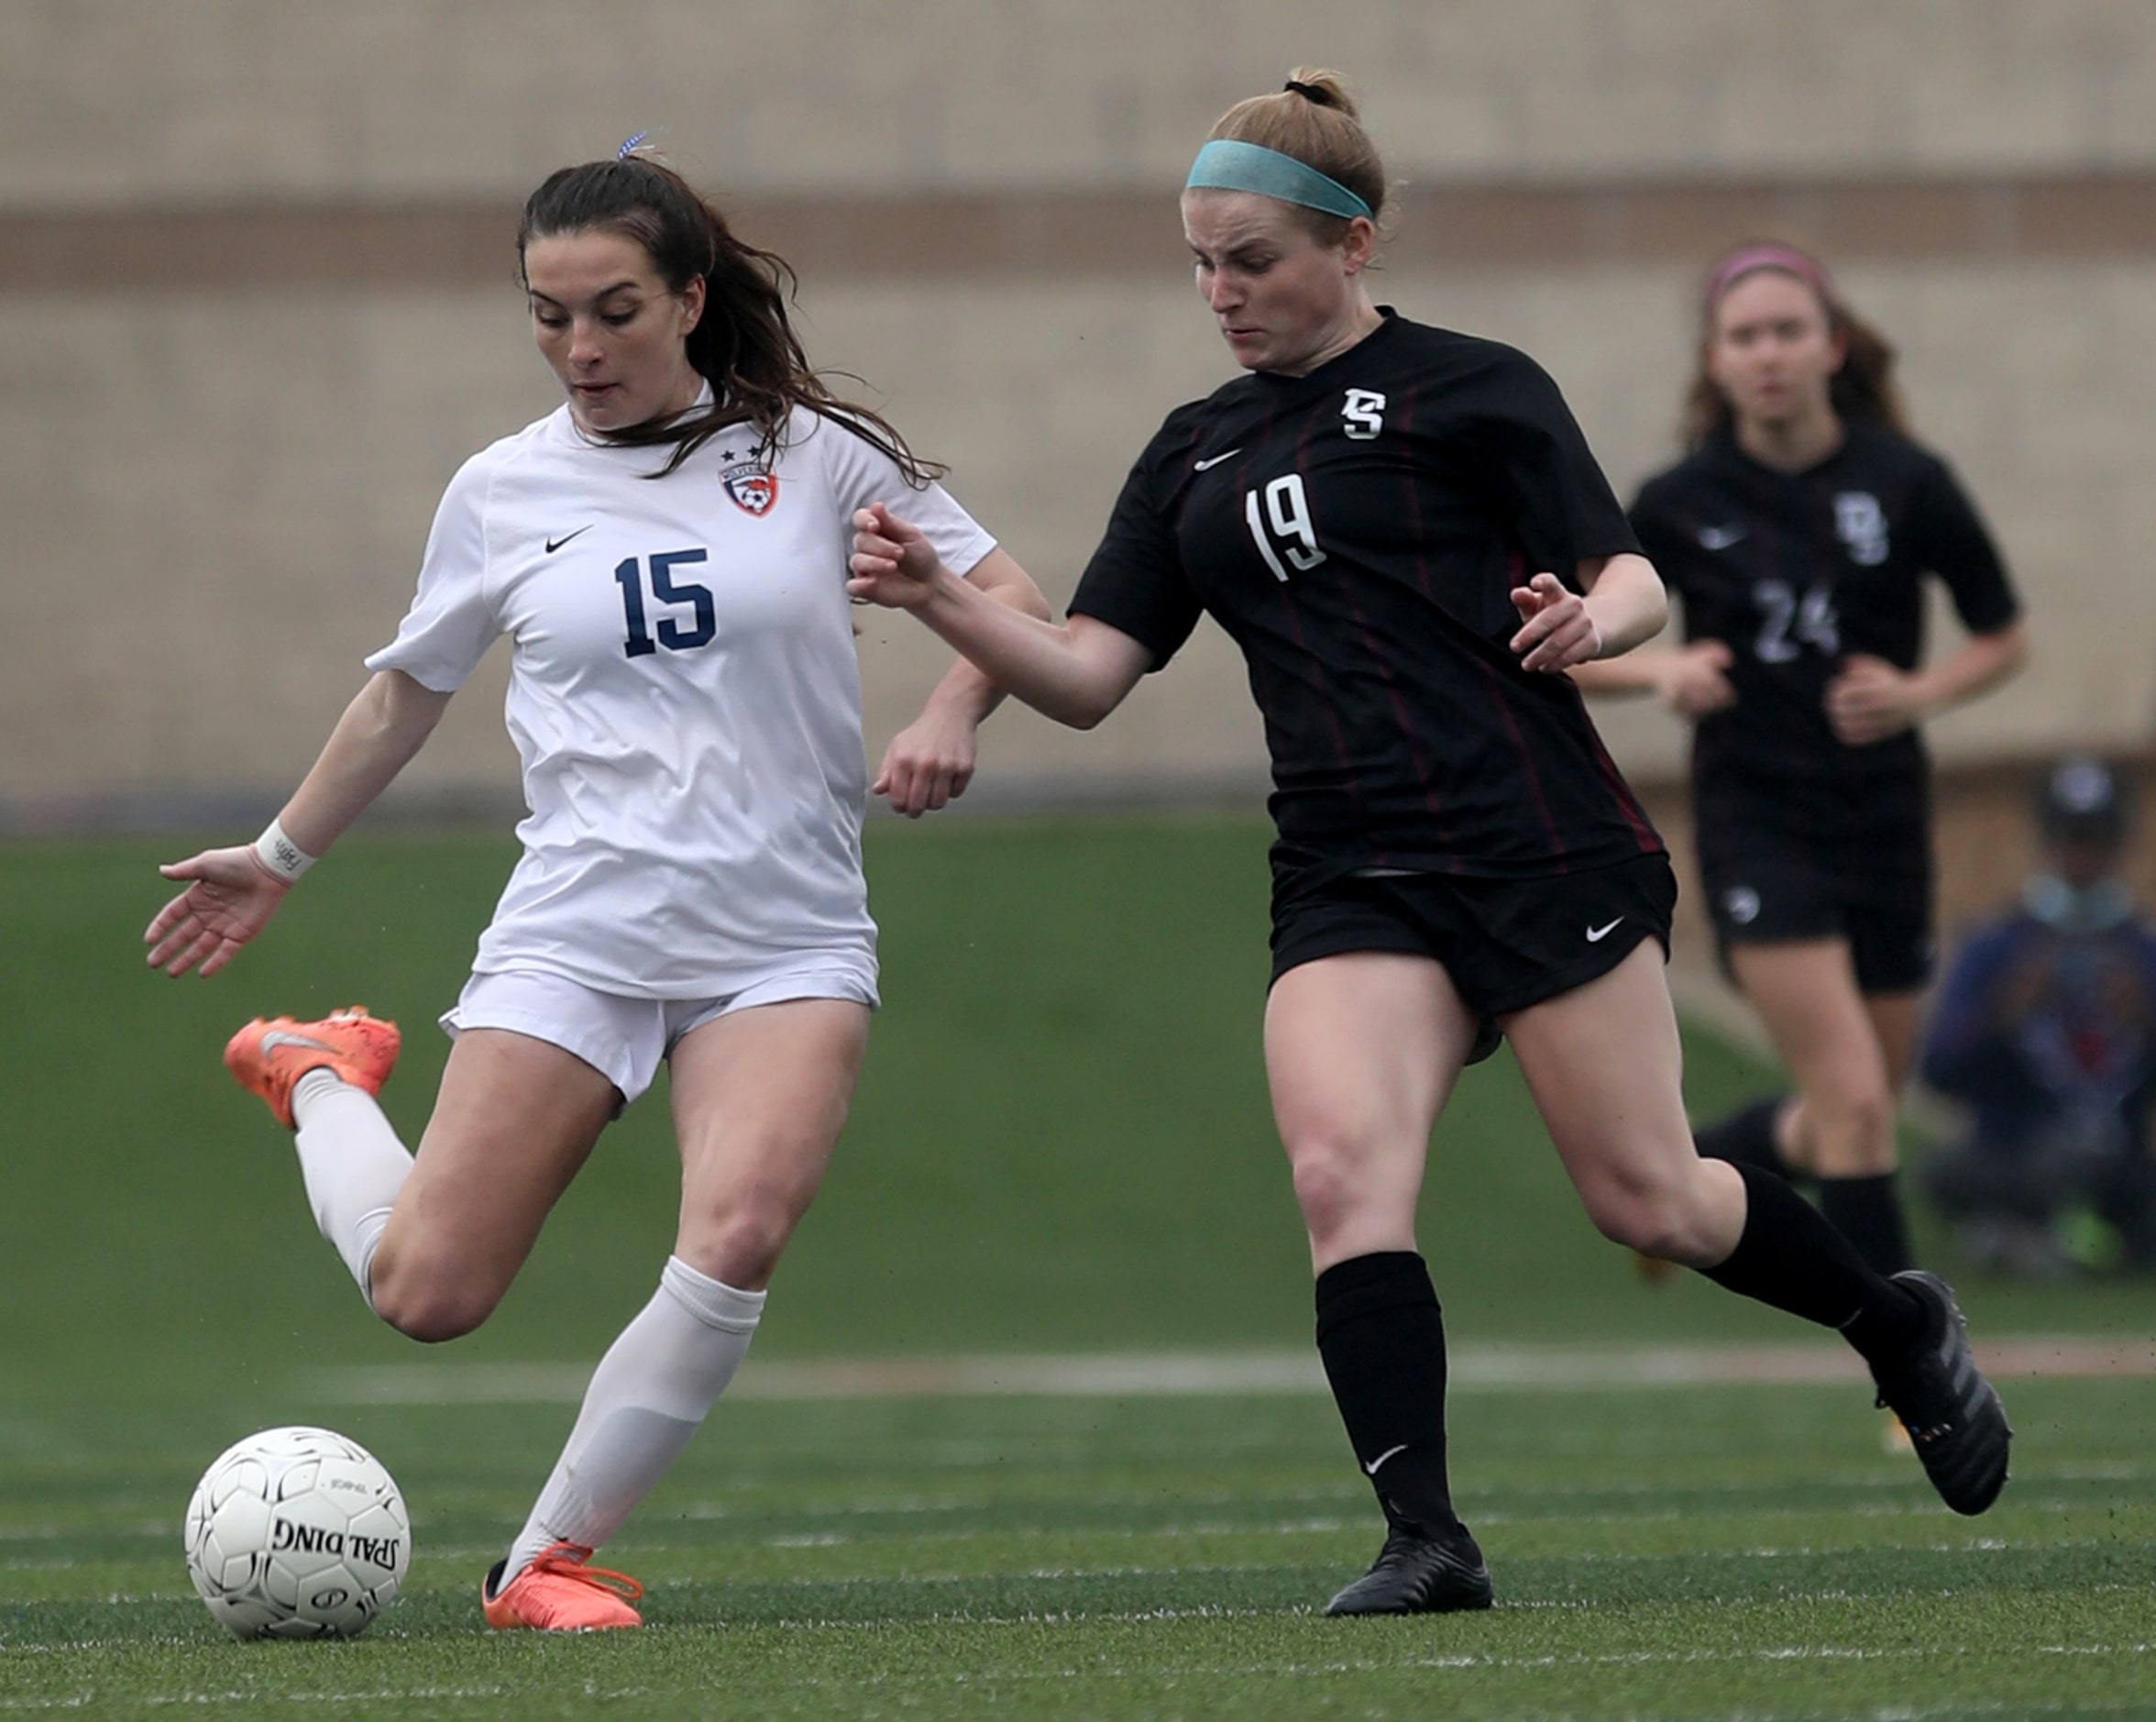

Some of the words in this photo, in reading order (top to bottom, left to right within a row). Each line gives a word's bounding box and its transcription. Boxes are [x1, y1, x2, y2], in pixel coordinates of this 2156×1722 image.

[1246, 473, 1326, 582] 19
[614, 547, 716, 658] 15
[1752, 579, 1840, 663] 24
[271, 1518, 400, 1571] SPALDING
